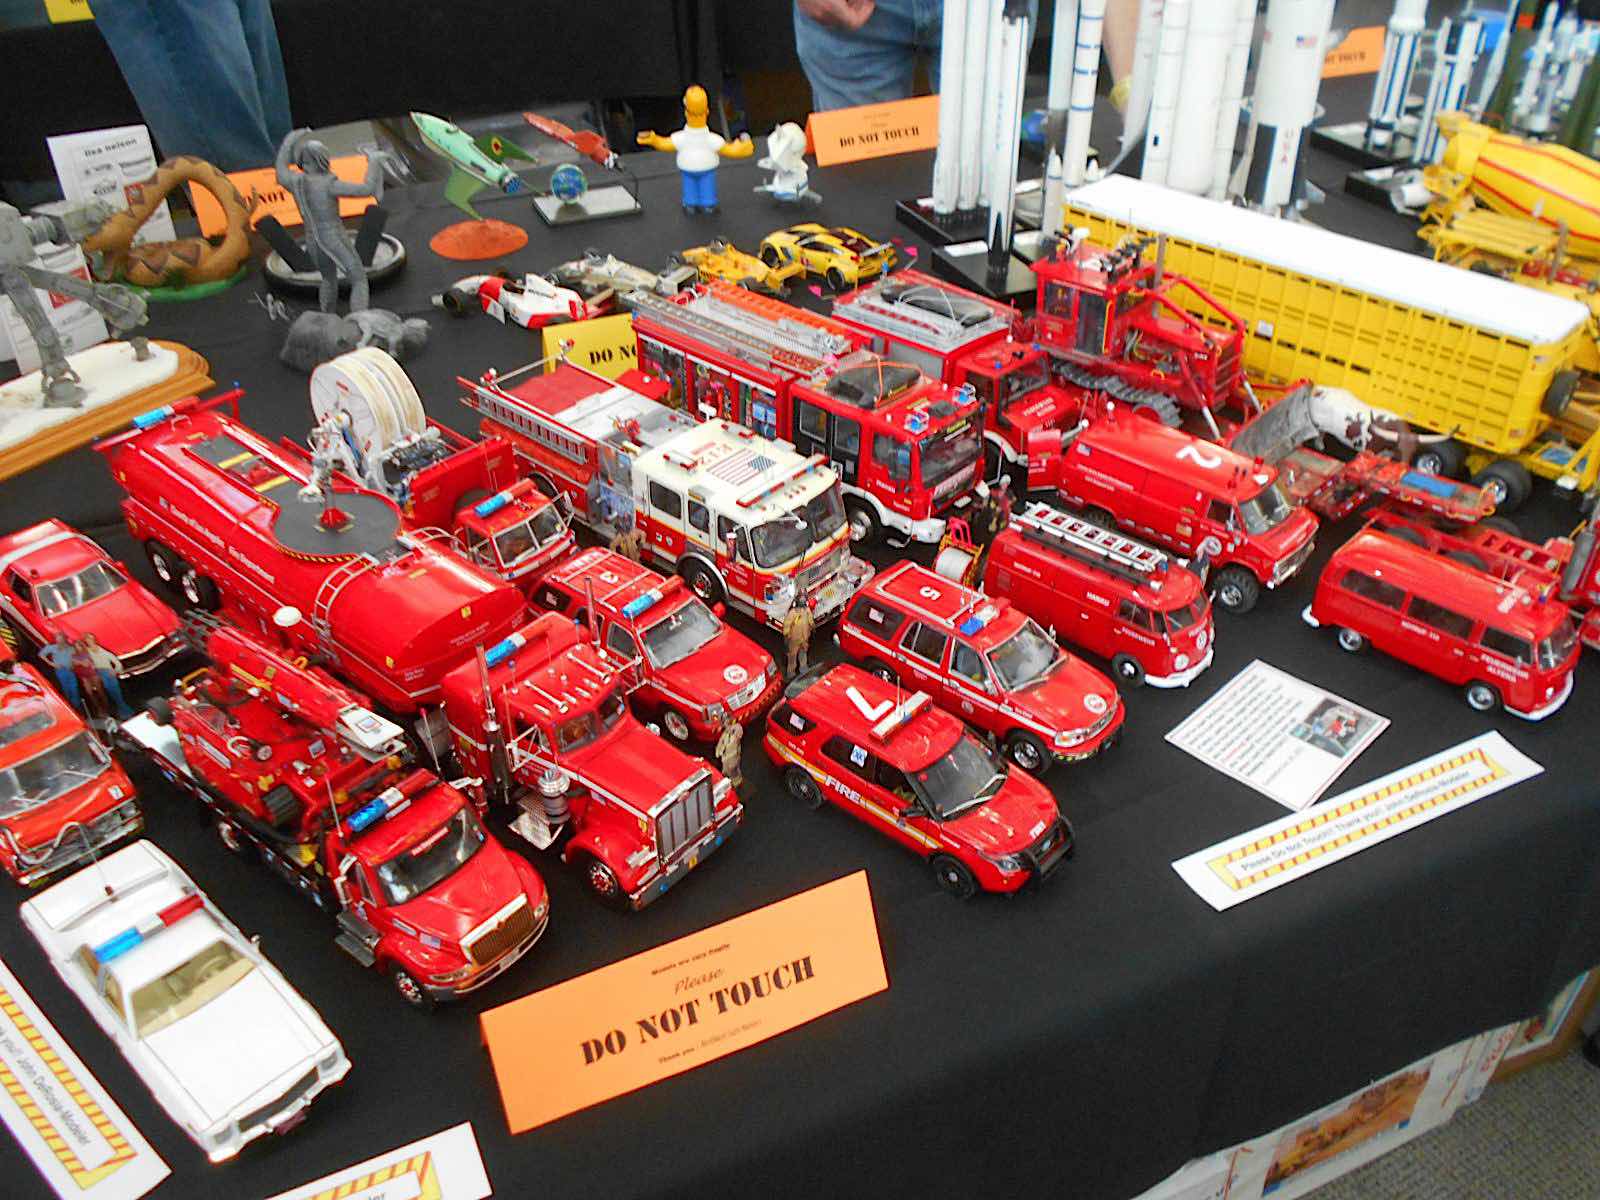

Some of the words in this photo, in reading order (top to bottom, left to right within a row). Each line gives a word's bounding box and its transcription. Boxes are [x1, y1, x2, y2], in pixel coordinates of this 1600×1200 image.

[840, 136, 854, 148] DO
[859, 132, 879, 144] NOT
[884, 126, 920, 142] TOUCH
[589, 348, 614, 365] DO
[824, 775, 865, 805] FIRE
[673, 967, 725, 995] Please
[580, 1028, 627, 1066] DO
[636, 998, 700, 1044] NOT
[709, 956, 815, 1015] TOUCH
